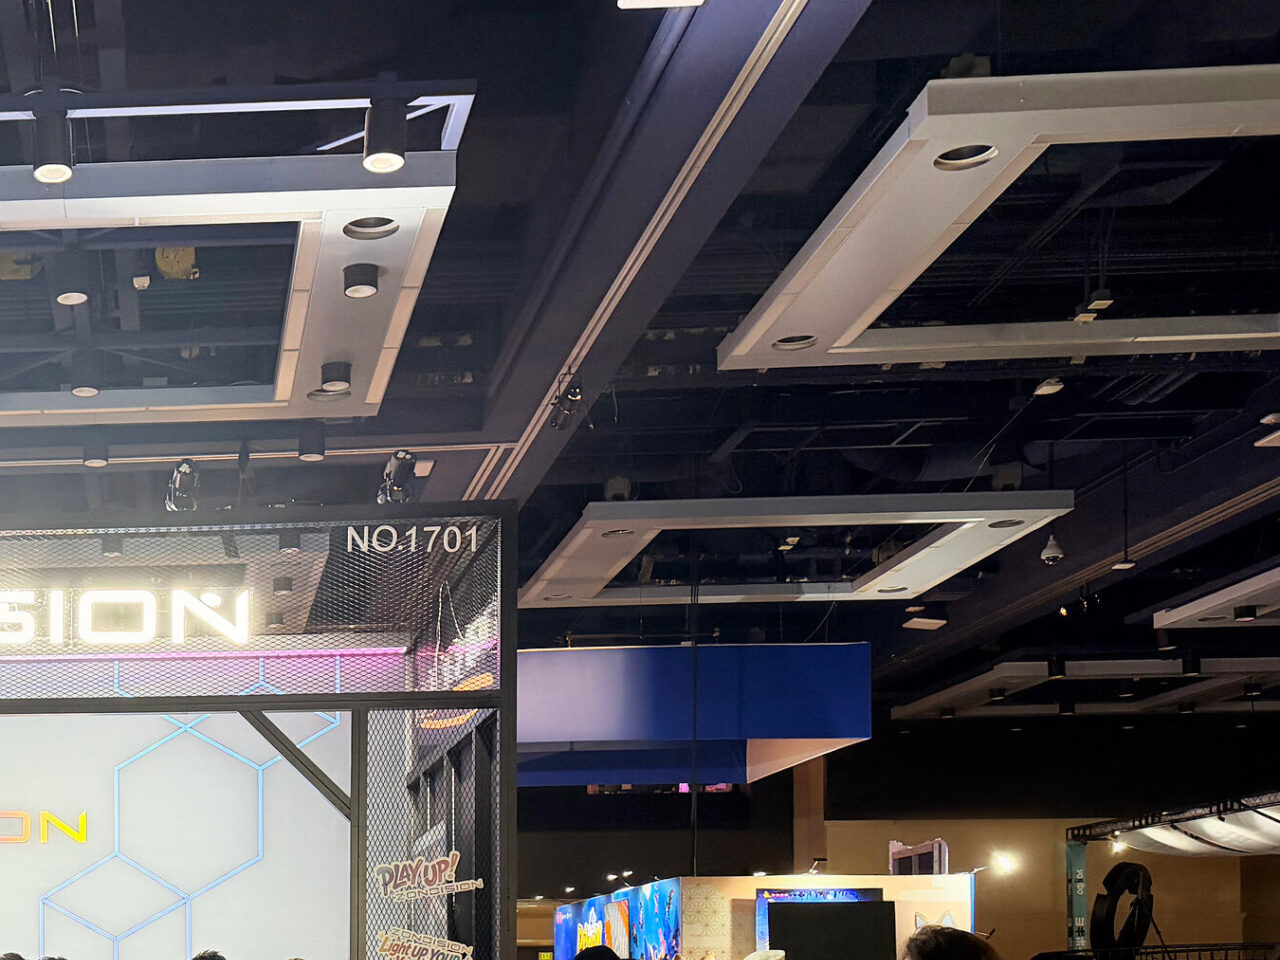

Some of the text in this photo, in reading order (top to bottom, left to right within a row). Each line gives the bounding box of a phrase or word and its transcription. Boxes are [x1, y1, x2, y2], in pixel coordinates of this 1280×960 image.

[347, 525, 477, 552] NO.1701
[377, 853, 459, 896] PLAY UP!
[380, 937, 411, 956] Light
